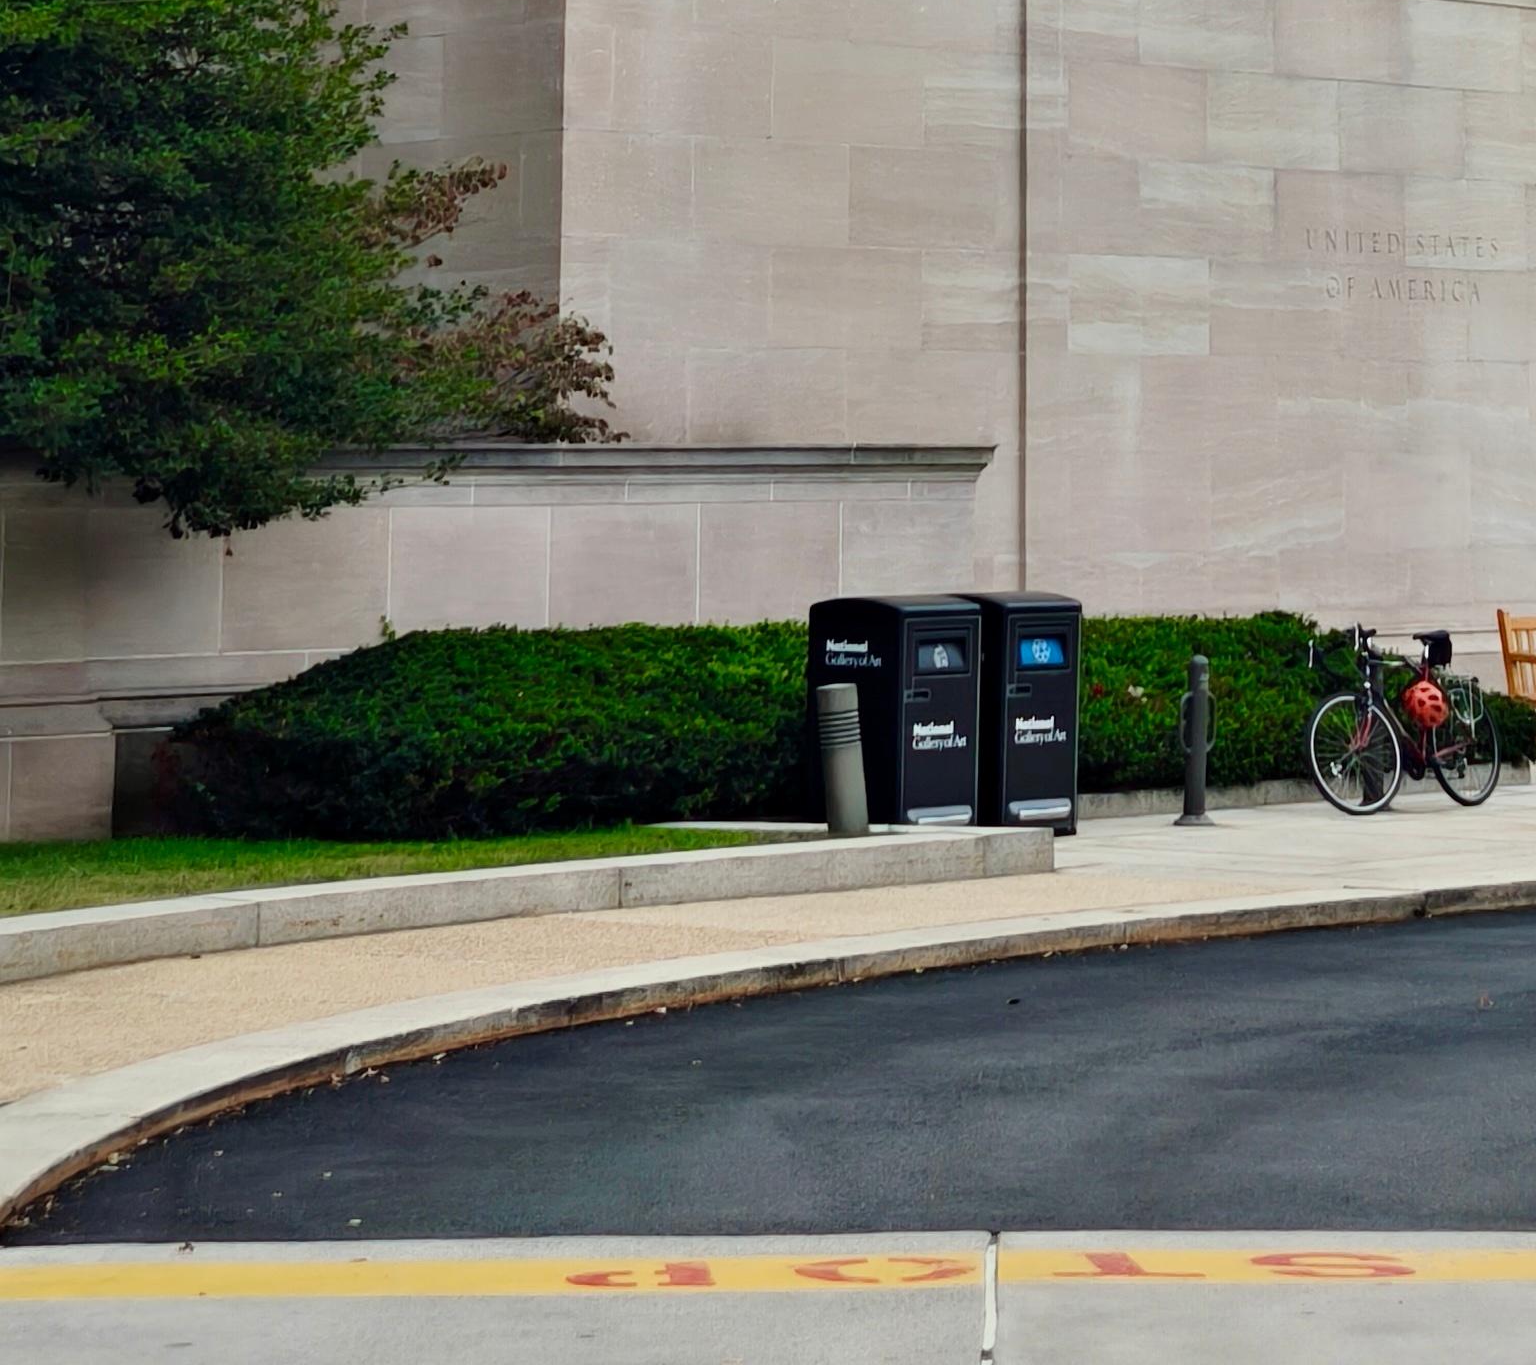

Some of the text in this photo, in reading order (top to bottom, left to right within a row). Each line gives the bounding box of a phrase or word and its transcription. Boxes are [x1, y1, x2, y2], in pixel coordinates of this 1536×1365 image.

[1305, 227, 1499, 259] UNITED STATES
[1326, 276, 1480, 305] OF AMERICA
[565, 1251, 1416, 1288] STOP
